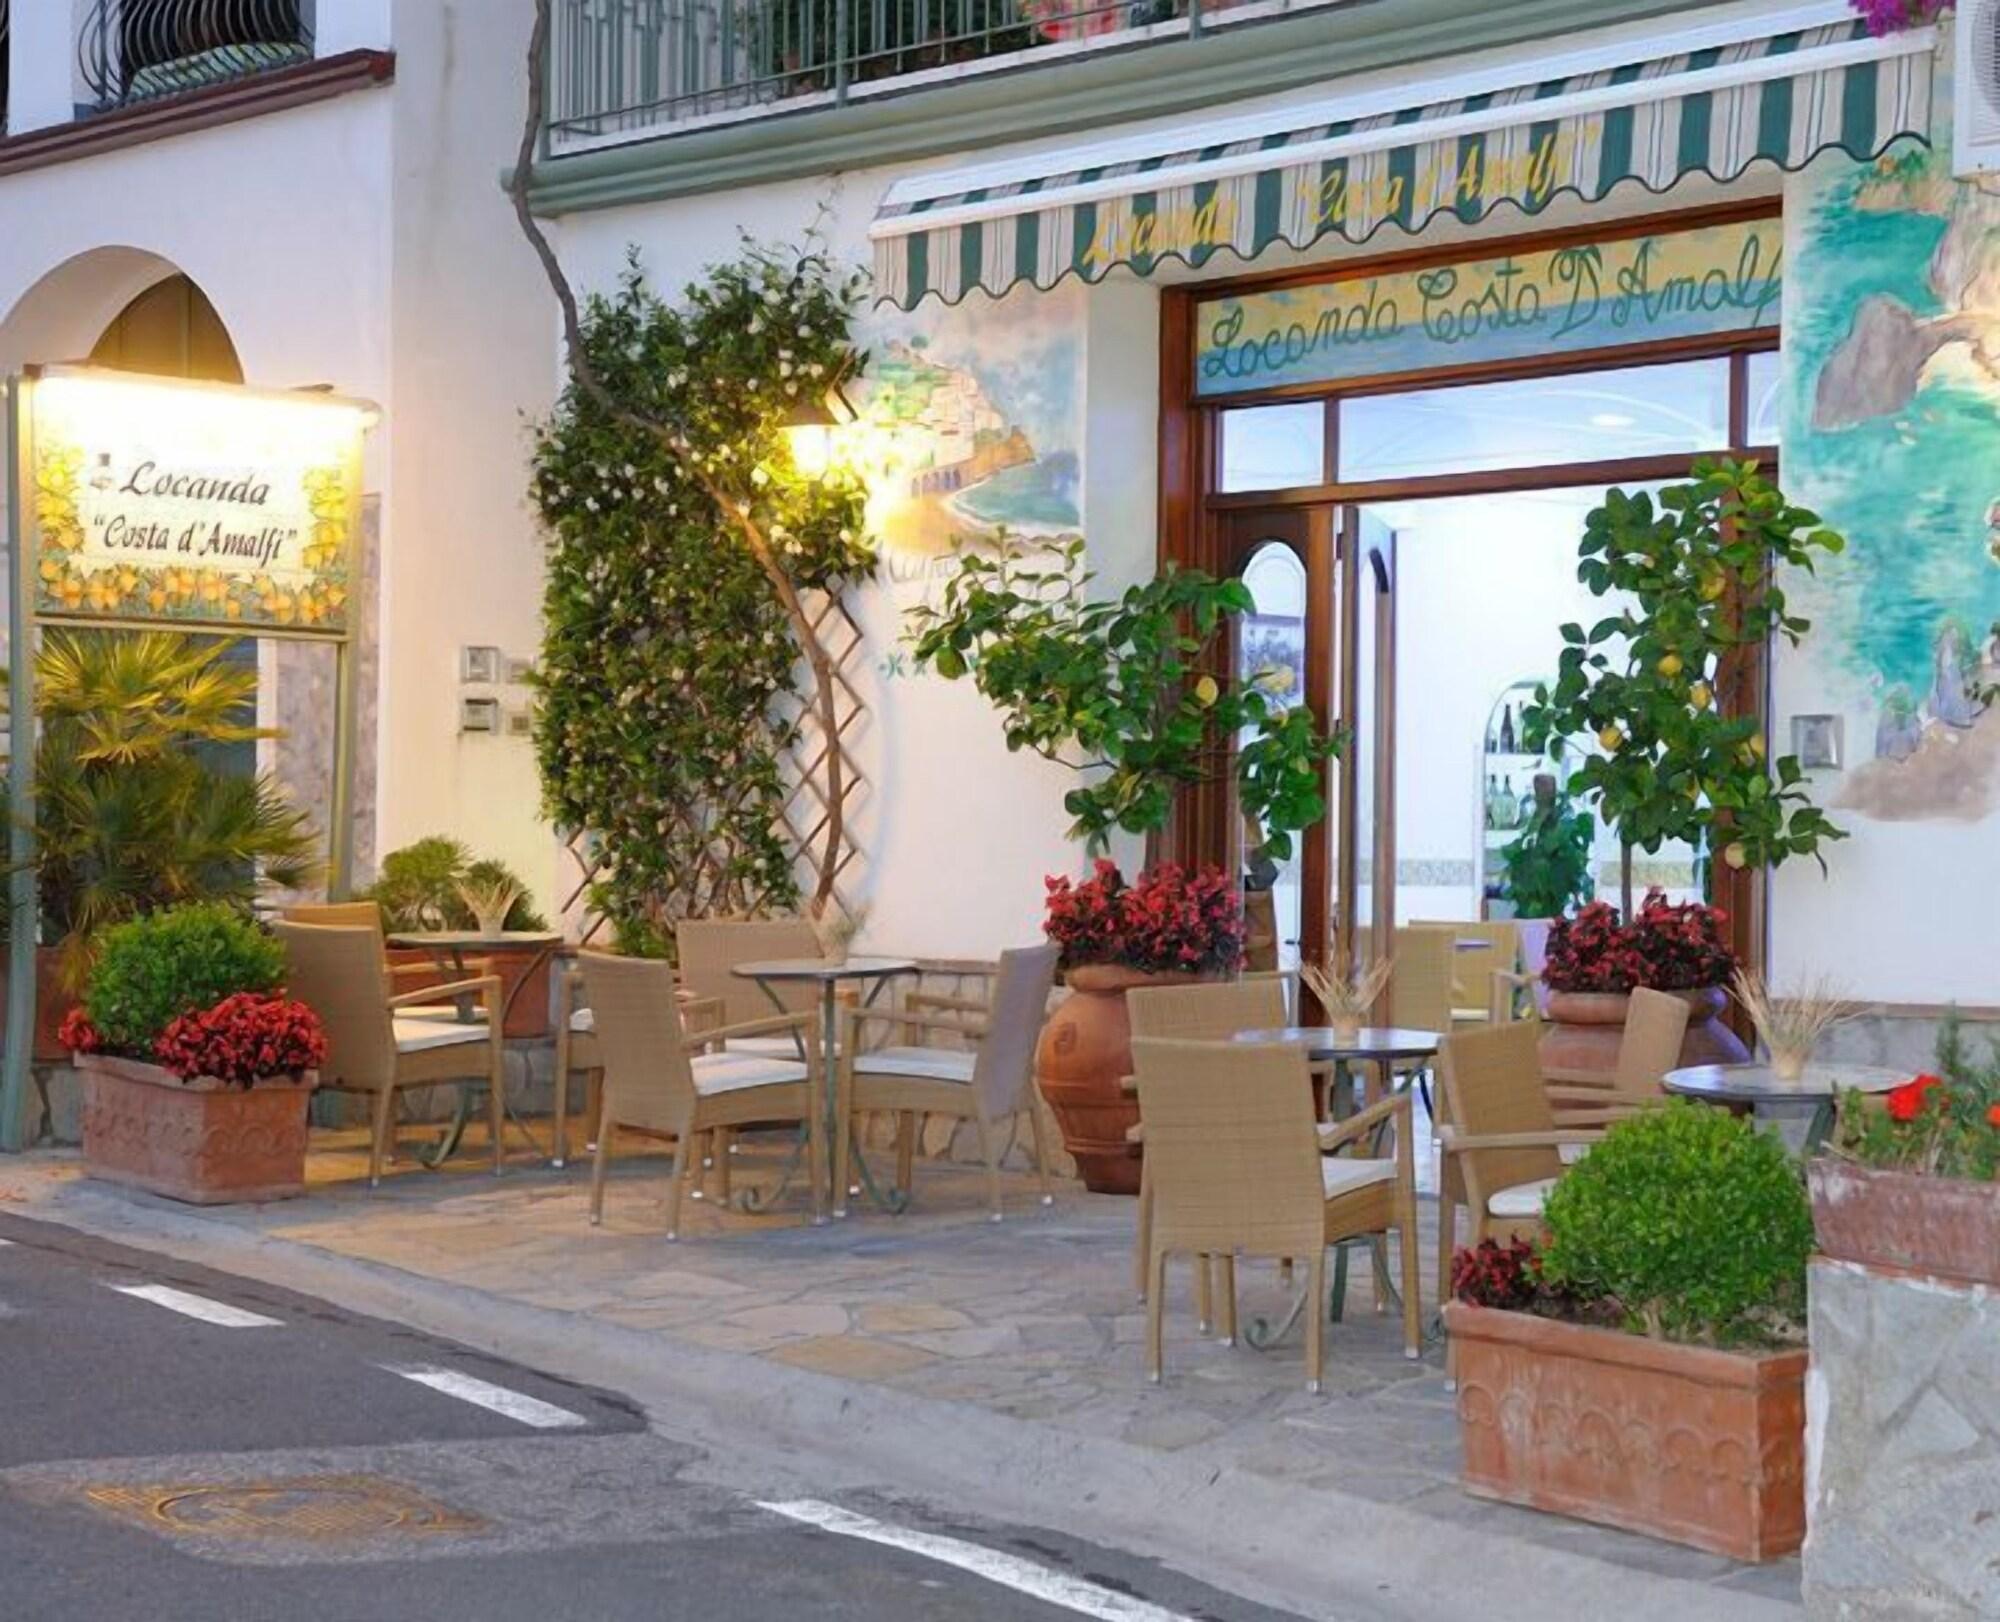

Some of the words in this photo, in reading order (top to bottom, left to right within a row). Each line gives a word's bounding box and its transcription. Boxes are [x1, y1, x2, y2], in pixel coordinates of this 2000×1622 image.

[1204, 280, 1402, 378] Locanda
[1416, 255, 1547, 344] Costa
[119, 460, 270, 506] Locanda
